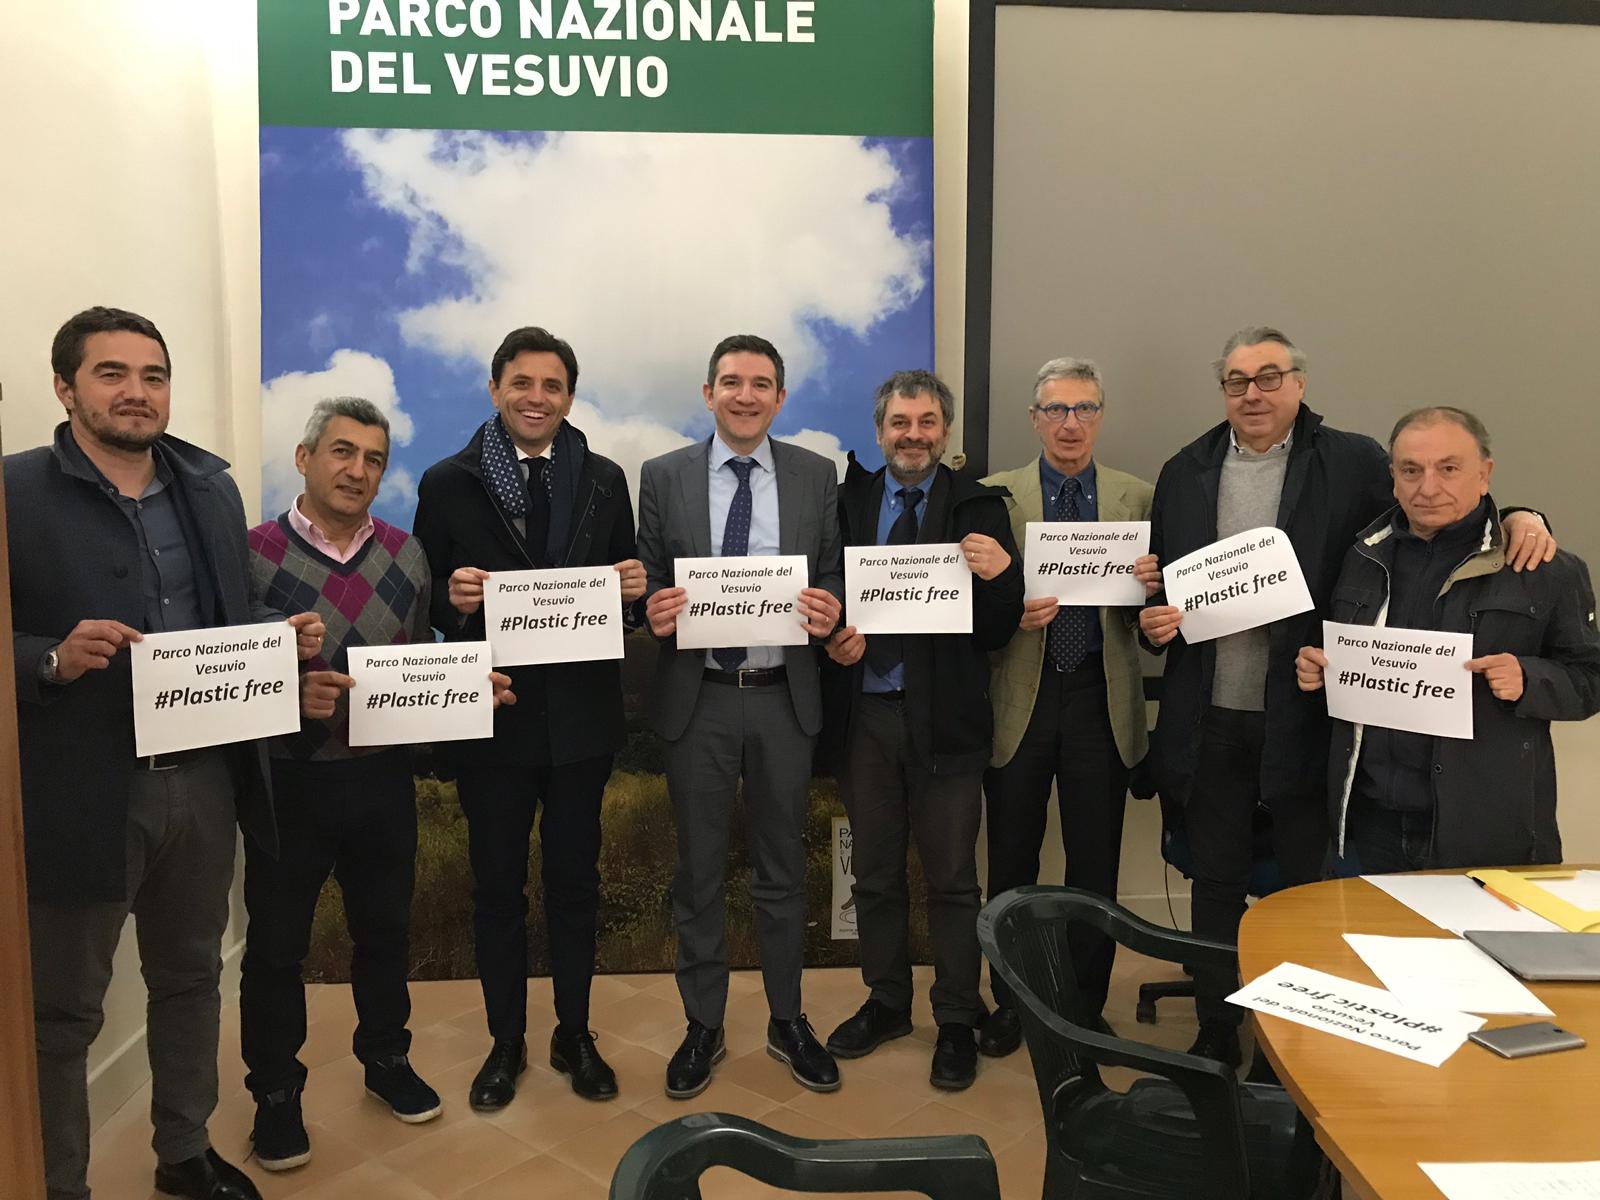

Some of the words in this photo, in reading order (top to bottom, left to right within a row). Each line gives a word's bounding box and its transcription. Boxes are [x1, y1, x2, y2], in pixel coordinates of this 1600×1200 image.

[329, 0, 502, 38] PARCO
[519, 0, 815, 43] NAZIONALE
[330, 50, 431, 94] DEL
[444, 53, 668, 97] VESUVIO
[1040, 533, 1068, 541] Parco
[1071, 532, 1120, 541] Nazionale
[1122, 532, 1138, 541] del
[1070, 546, 1107, 555] Vesuvio
[1177, 563, 1202, 578] Parco
[1204, 542, 1257, 567] Nazionale
[1259, 536, 1274, 548] del
[860, 558, 888, 566] Parco
[891, 555, 940, 566] Nazionale
[943, 554, 959, 564] del
[1037, 562, 1100, 576] #Plastic
[1101, 561, 1135, 577] free
[689, 570, 718, 579] Parco
[721, 568, 773, 578] Nazionale
[776, 567, 792, 576] del
[890, 570, 928, 580] Vesuvio
[1208, 560, 1249, 581] Vesuvio
[499, 581, 530, 592] Parco
[533, 579, 586, 591] Nazionale
[589, 578, 606, 588] del
[721, 583, 761, 593] Vesuvio
[1184, 581, 1249, 612] #Plastic
[1253, 571, 1287, 594] free
[533, 595, 575, 606] Vesuvio
[860, 587, 923, 602] #Plastic
[925, 586, 959, 604] free
[689, 601, 755, 616] #Plastic
[758, 600, 792, 617] free
[500, 613, 569, 631] #Plastic
[572, 612, 607, 630] free
[153, 648, 191, 660] Parco
[195, 639, 259, 656] Nazionale
[263, 636, 281, 648] del
[1337, 636, 1368, 648] Parco
[1372, 640, 1432, 654] Nazionale
[1436, 645, 1456, 656] del
[196, 660, 246, 675] Vesuvio
[366, 656, 400, 668] Parco
[402, 653, 459, 666] Nazionale
[461, 653, 479, 663] del
[1371, 656, 1417, 670] Vesuvio
[402, 671, 446, 682] Vesuvio
[1339, 671, 1410, 694] #Plastic
[1412, 680, 1455, 699] free
[155, 683, 239, 710] #Plastic
[243, 678, 284, 702] free
[366, 690, 439, 709] #Plastic
[442, 689, 479, 708] free
[1278, 981, 1336, 1000] free
[1252, 996, 1280, 1007] del
[1283, 1005, 1366, 1034] Nazionale
[1312, 1004, 1375, 1028] Vesuvio
[1334, 995, 1443, 1034] #Plastic
[1370, 1032, 1421, 1051] Parco
